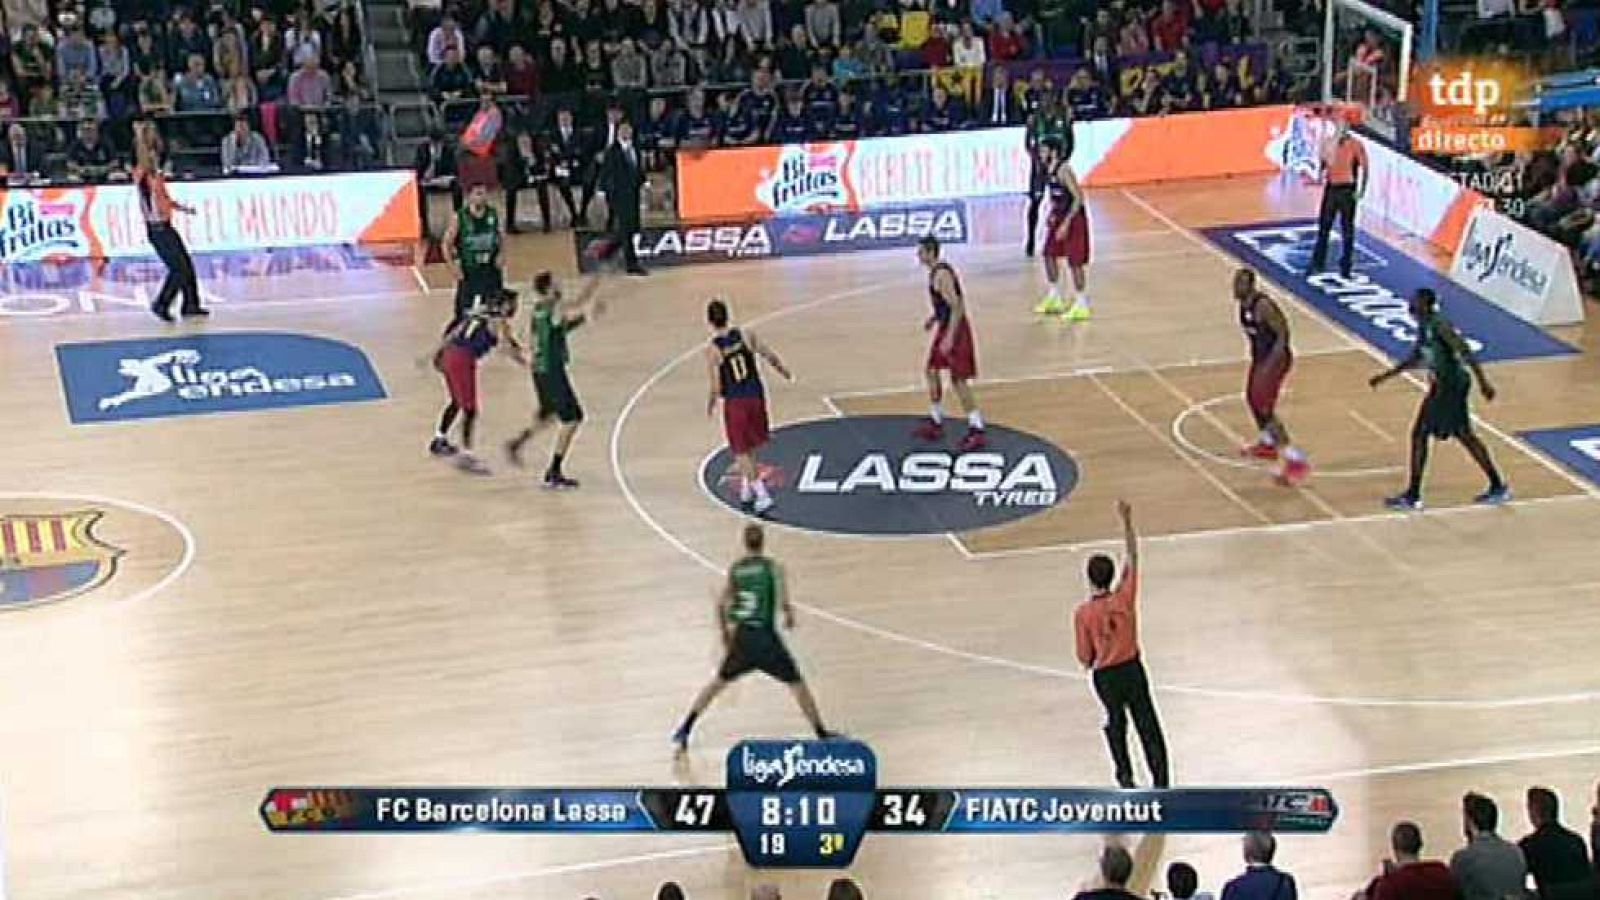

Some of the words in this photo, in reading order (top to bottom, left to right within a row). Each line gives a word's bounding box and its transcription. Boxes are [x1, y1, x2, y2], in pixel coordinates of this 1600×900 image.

[783, 152, 806, 182] Bi
[773, 171, 838, 209] frutas
[235, 189, 341, 241] MUNDO
[823, 210, 963, 241] LASSA
[632, 224, 771, 256] LASSA
[796, 452, 1057, 493] LASSA
